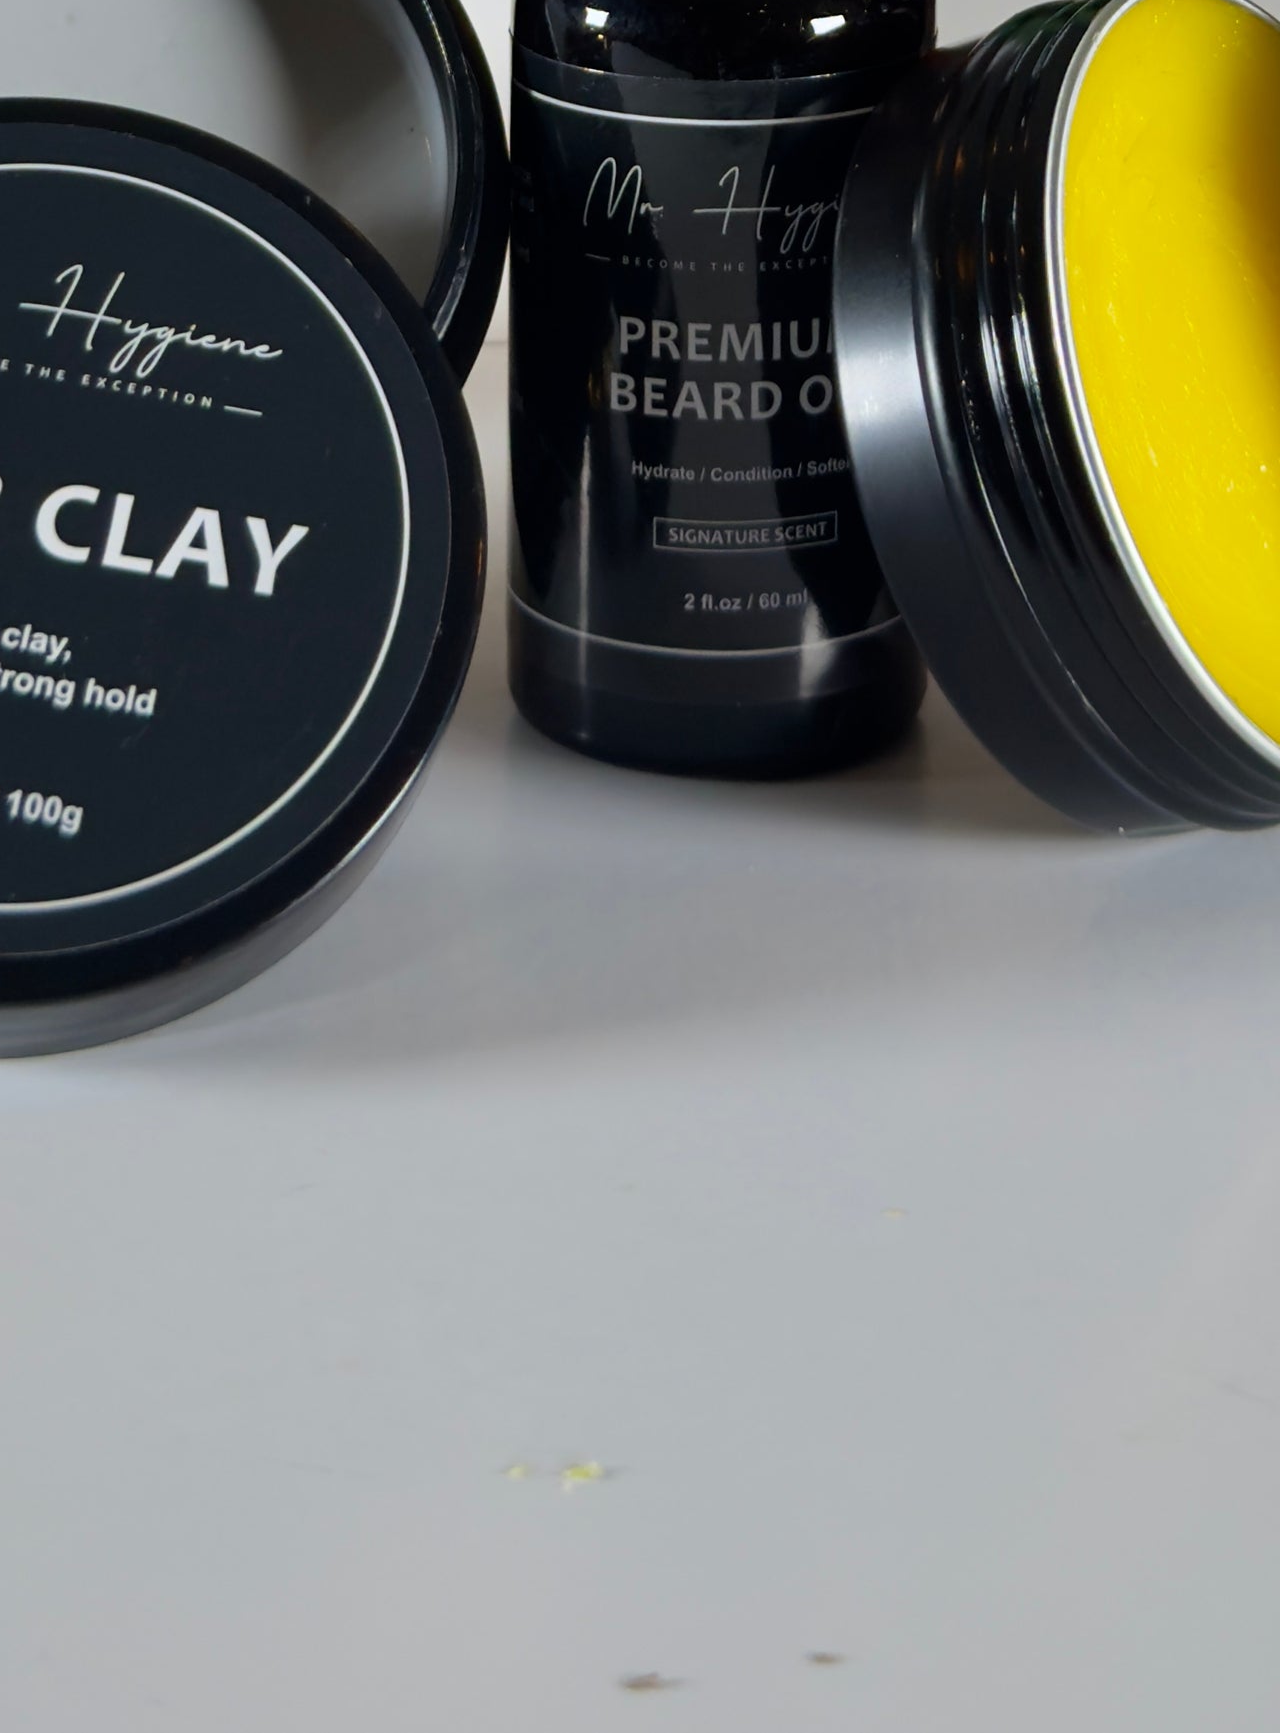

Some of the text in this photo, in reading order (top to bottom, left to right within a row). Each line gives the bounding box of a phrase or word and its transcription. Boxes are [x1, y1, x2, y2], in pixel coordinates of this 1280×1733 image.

[693, 165, 840, 254] Hygi
[622, 254, 828, 272] BECOME THE EXCEPT
[19, 263, 283, 379] Hygiene
[619, 315, 833, 363] PREMIU
[25, 362, 66, 383] THE
[81, 372, 214, 409] EXCEPTION
[609, 371, 783, 421] BEARD
[630, 458, 696, 484] Hydrate
[709, 461, 794, 483] Condition
[806, 456, 850, 477] Softe
[32, 482, 311, 599] CLAY
[667, 520, 828, 546] SIGNATURE SCENT
[683, 592, 695, 611] 2
[700, 591, 742, 613] fl.oz
[758, 591, 782, 609] 60
[0, 623, 72, 666] clay,
[82, 677, 158, 718] hold
[6, 789, 84, 838] 100g
